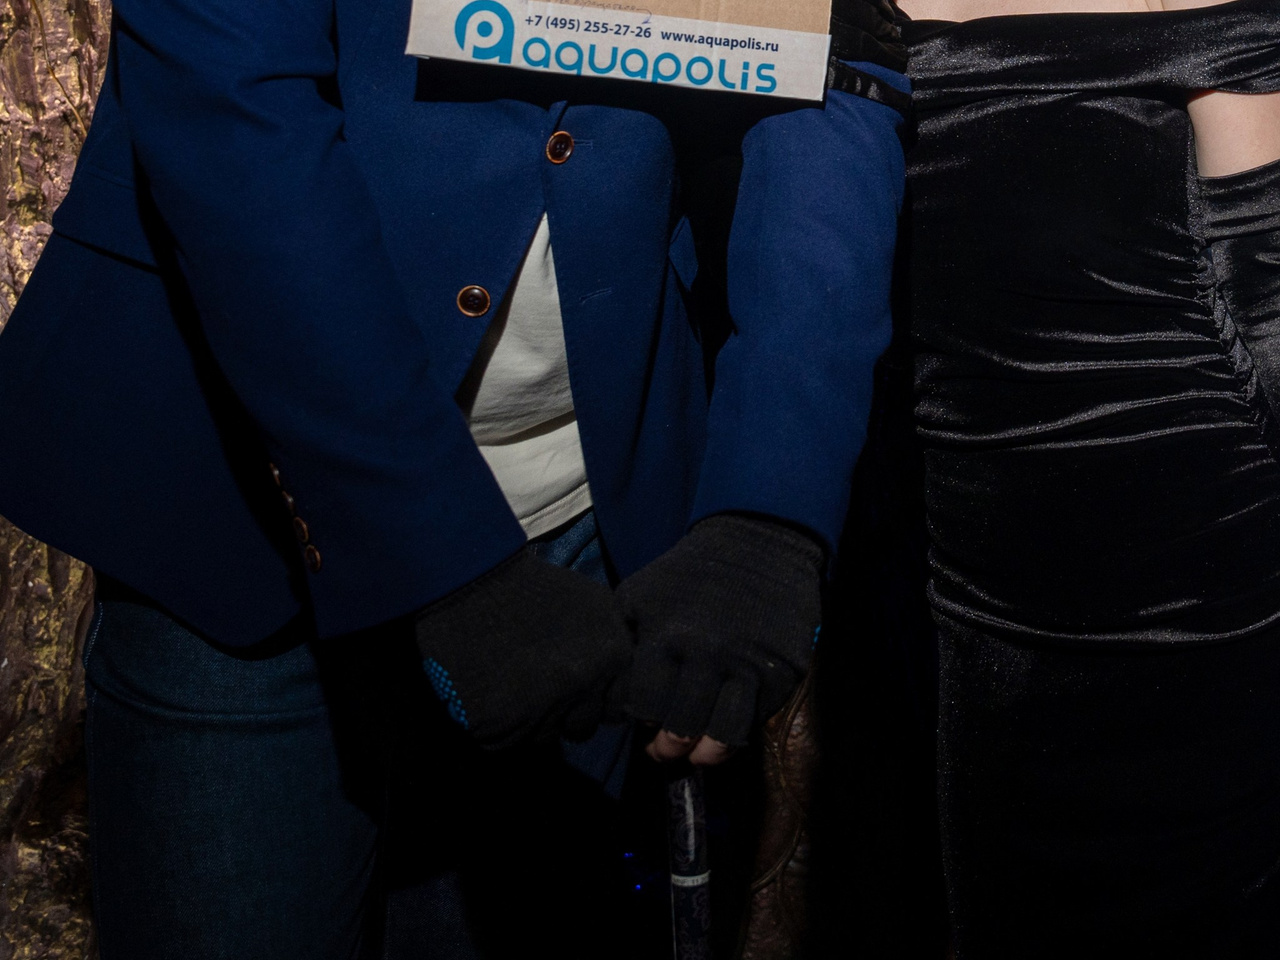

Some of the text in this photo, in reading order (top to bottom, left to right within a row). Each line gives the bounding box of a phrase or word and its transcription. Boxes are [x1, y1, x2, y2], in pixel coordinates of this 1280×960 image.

[525, 15, 779, 53] +7 (495) 255-27-26 www.aquapolis.ru
[522, 37, 777, 93] aquapolis
